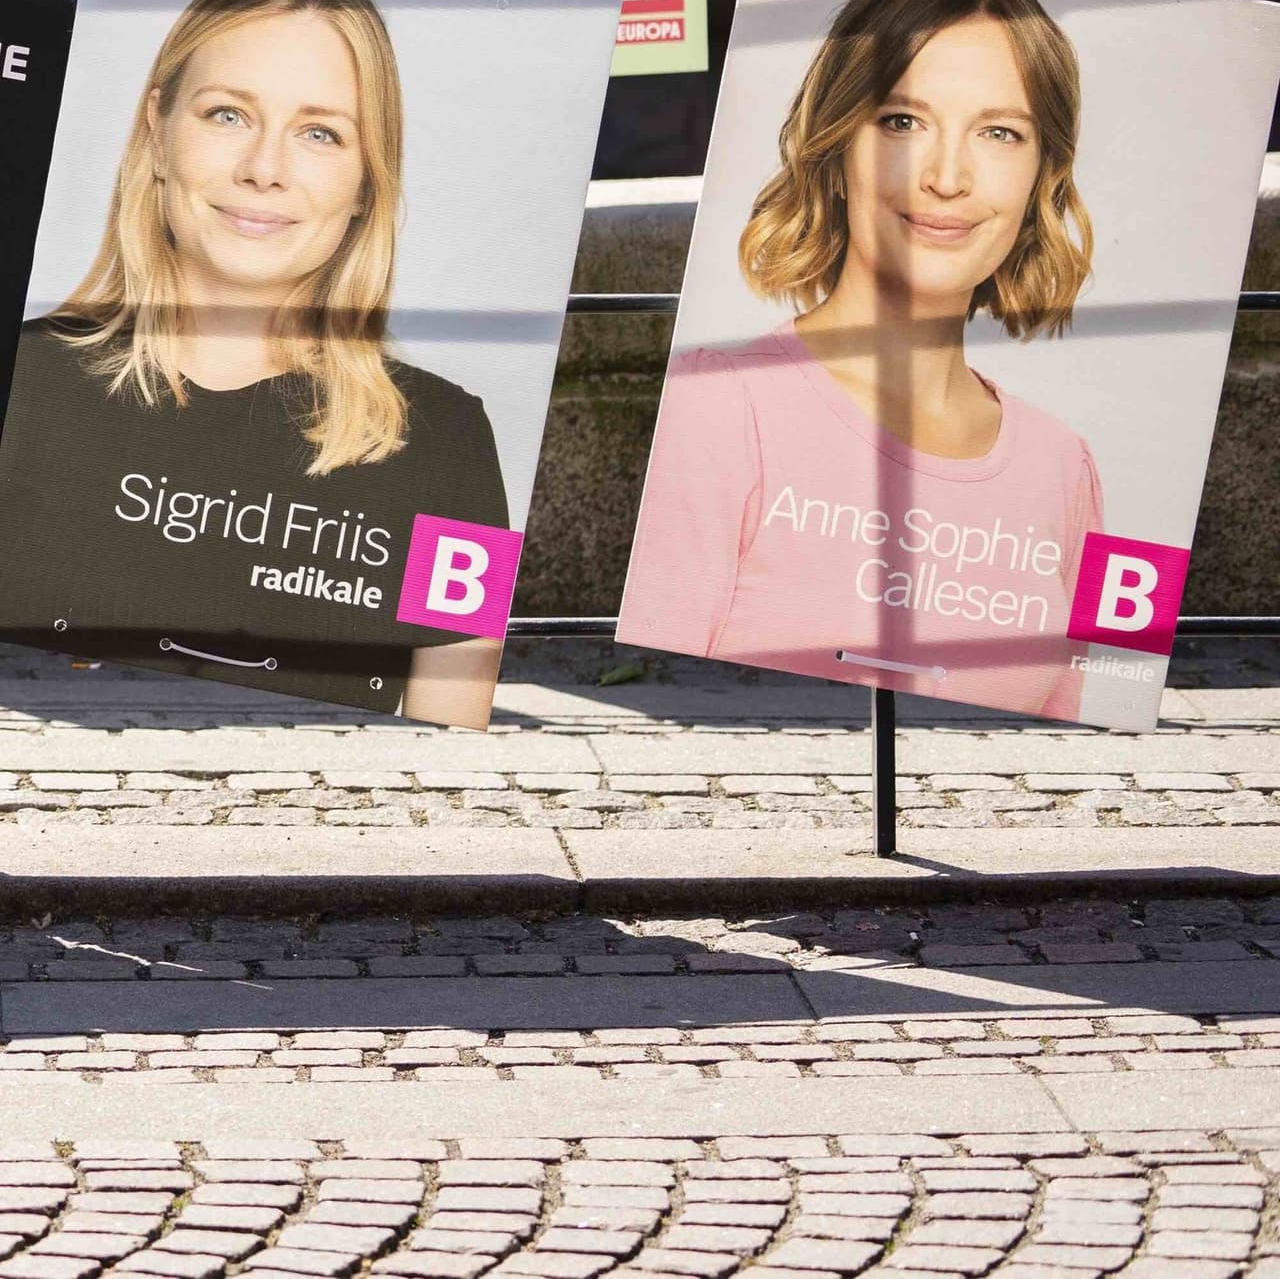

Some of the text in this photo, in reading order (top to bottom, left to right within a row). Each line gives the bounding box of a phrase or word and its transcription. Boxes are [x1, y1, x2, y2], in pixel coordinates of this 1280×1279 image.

[617, 21, 681, 42] EUROPA
[115, 473, 392, 567] Sigrid Friis
[764, 485, 1062, 576] Anne Sophie
[250, 562, 383, 610] radikale
[425, 534, 490, 616] B
[855, 558, 1048, 632] Callesen
[1095, 553, 1159, 633] B
[1070, 652, 1155, 683] radikale
